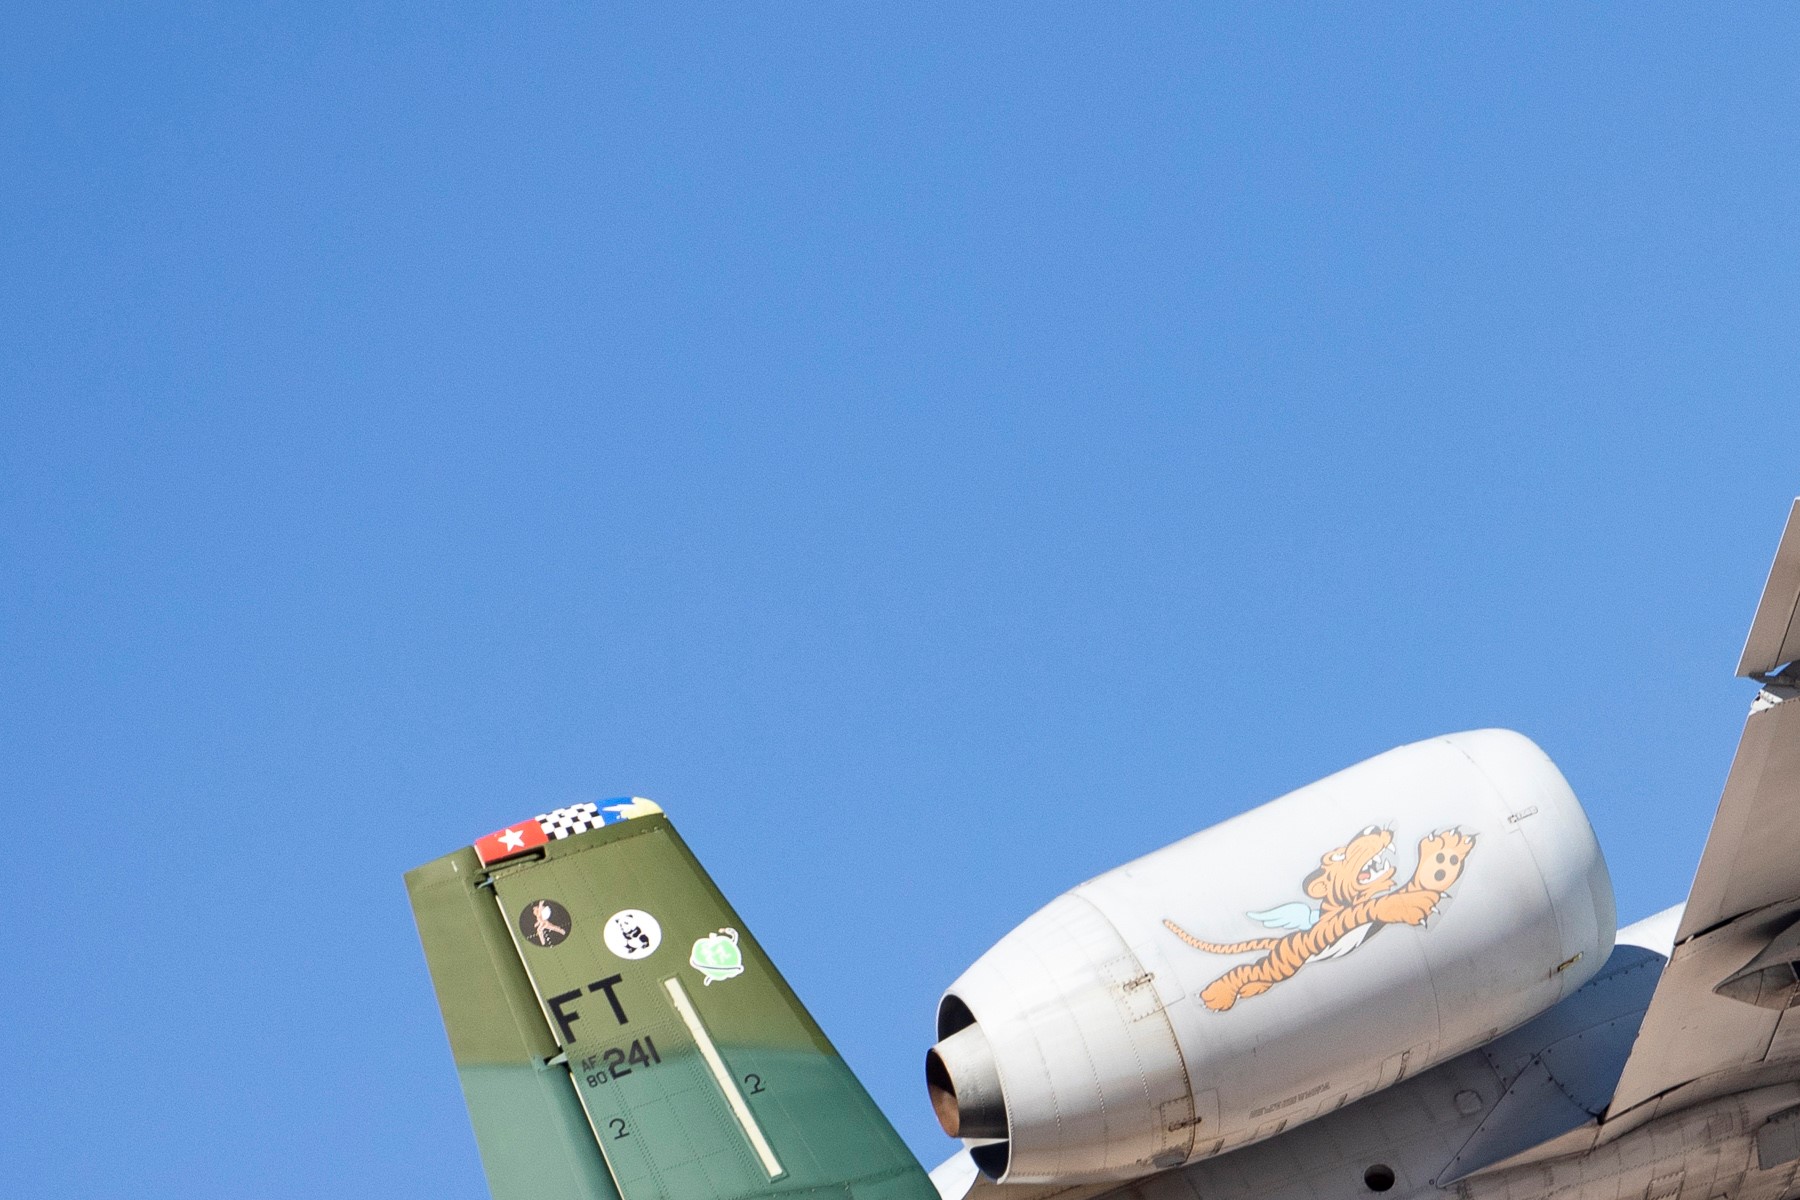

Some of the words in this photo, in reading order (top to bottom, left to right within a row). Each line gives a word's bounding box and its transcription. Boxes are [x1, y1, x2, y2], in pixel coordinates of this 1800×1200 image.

[547, 973, 629, 1045] FT
[581, 1055, 599, 1074] AF
[603, 1035, 662, 1080] 241
[586, 1071, 609, 1088] 80
